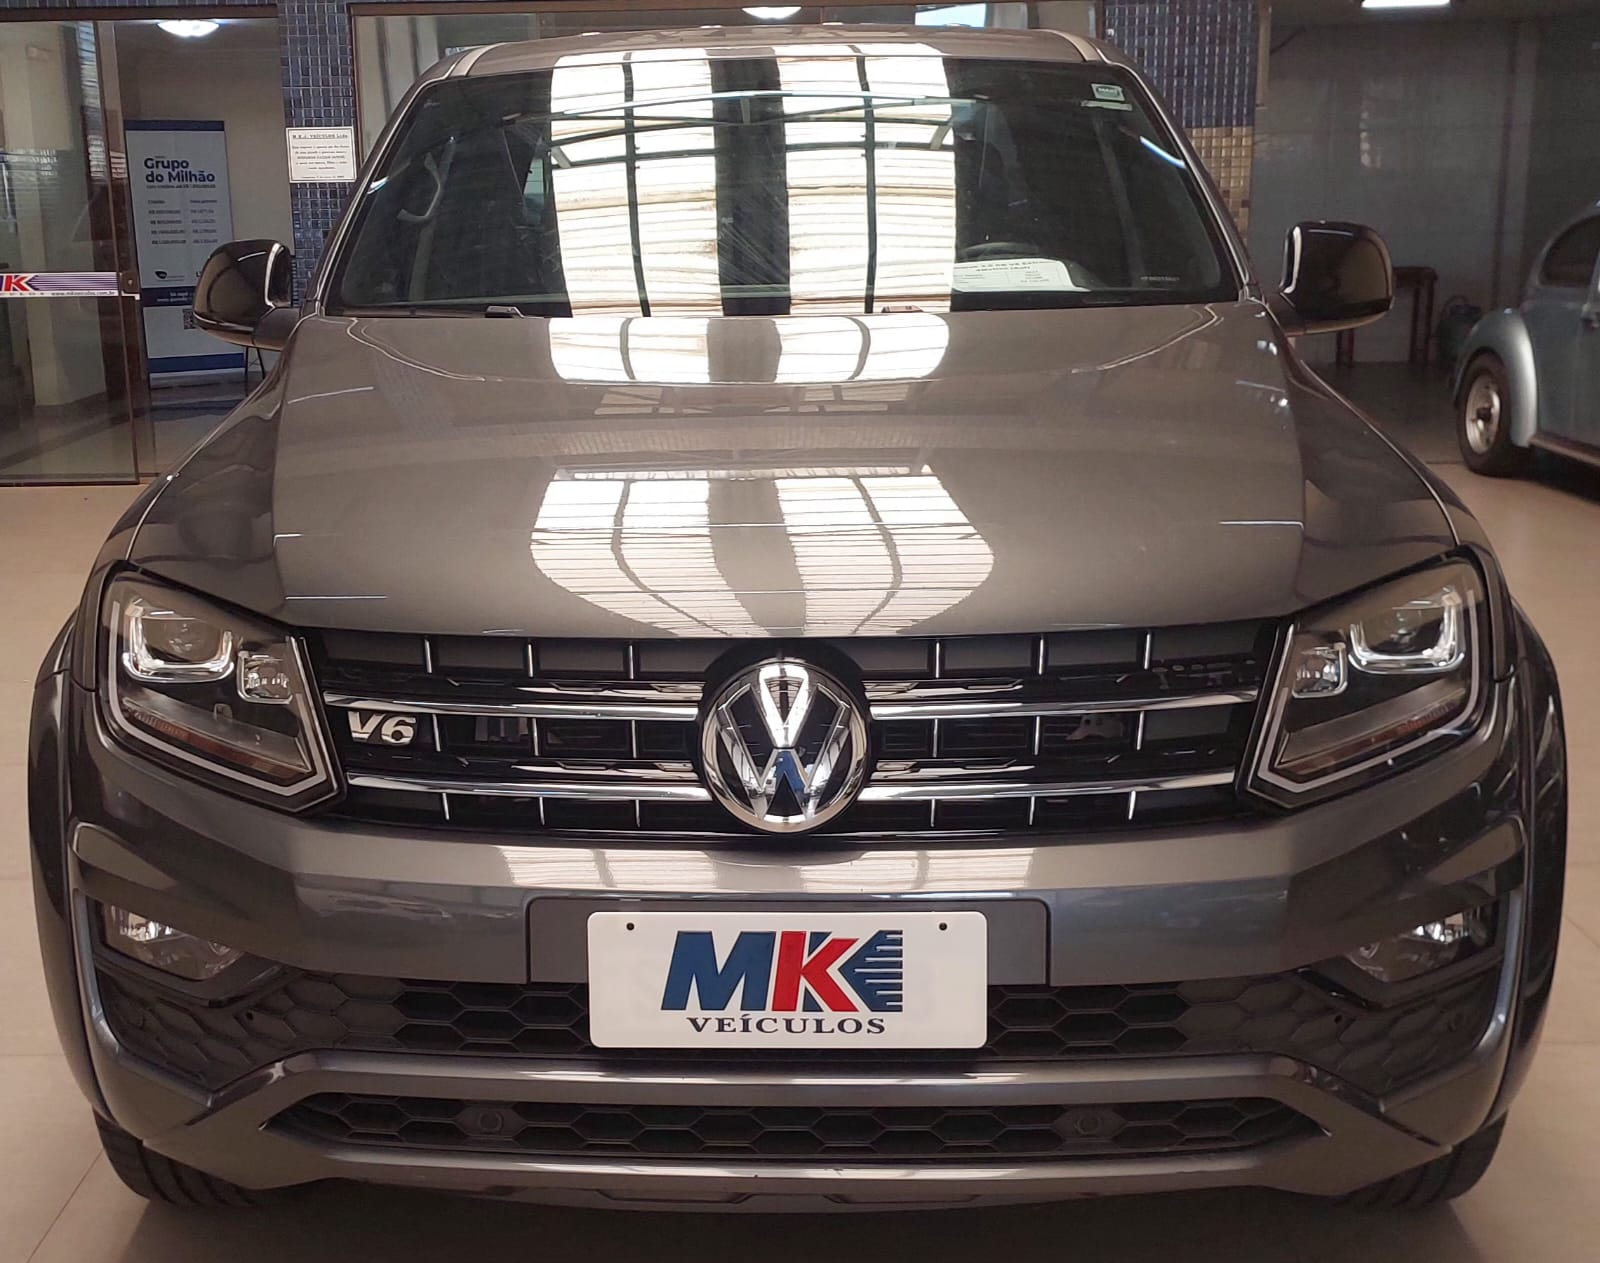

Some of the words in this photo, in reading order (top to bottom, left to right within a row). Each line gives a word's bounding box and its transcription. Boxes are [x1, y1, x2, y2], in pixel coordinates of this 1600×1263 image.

[144, 157, 190, 171] Grupo
[145, 171, 164, 183] do
[167, 170, 216, 183] Milhão
[0, 274, 30, 292] K
[347, 710, 417, 746] V6
[661, 930, 862, 1012] MK
[686, 1014, 886, 1035] VEÍCULOS
